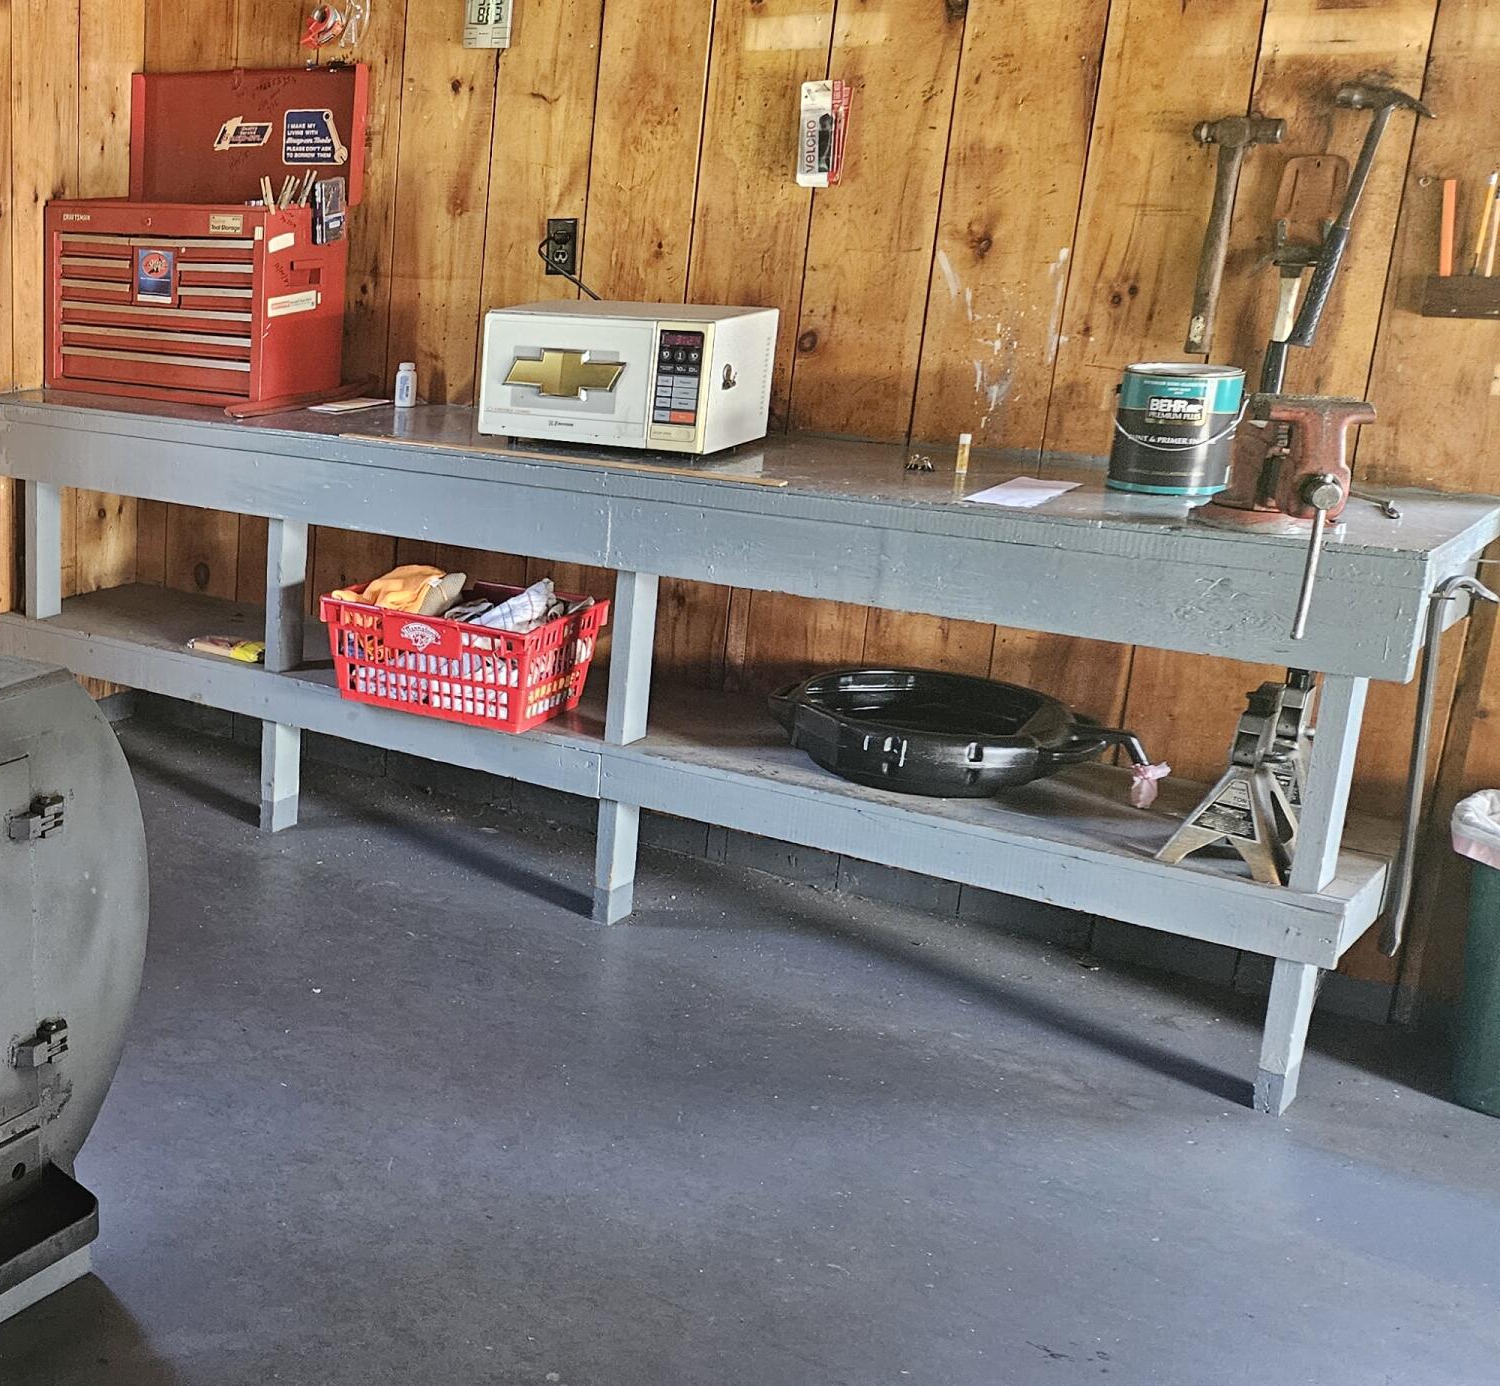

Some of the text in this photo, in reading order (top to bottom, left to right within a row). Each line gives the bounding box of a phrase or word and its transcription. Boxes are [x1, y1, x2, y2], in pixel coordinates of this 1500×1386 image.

[221, 224, 240, 232] Storage
[1149, 398, 1189, 413] BEHR
[1148, 412, 1182, 420] PREMIUM
[1157, 436, 1188, 445] PRIMER
